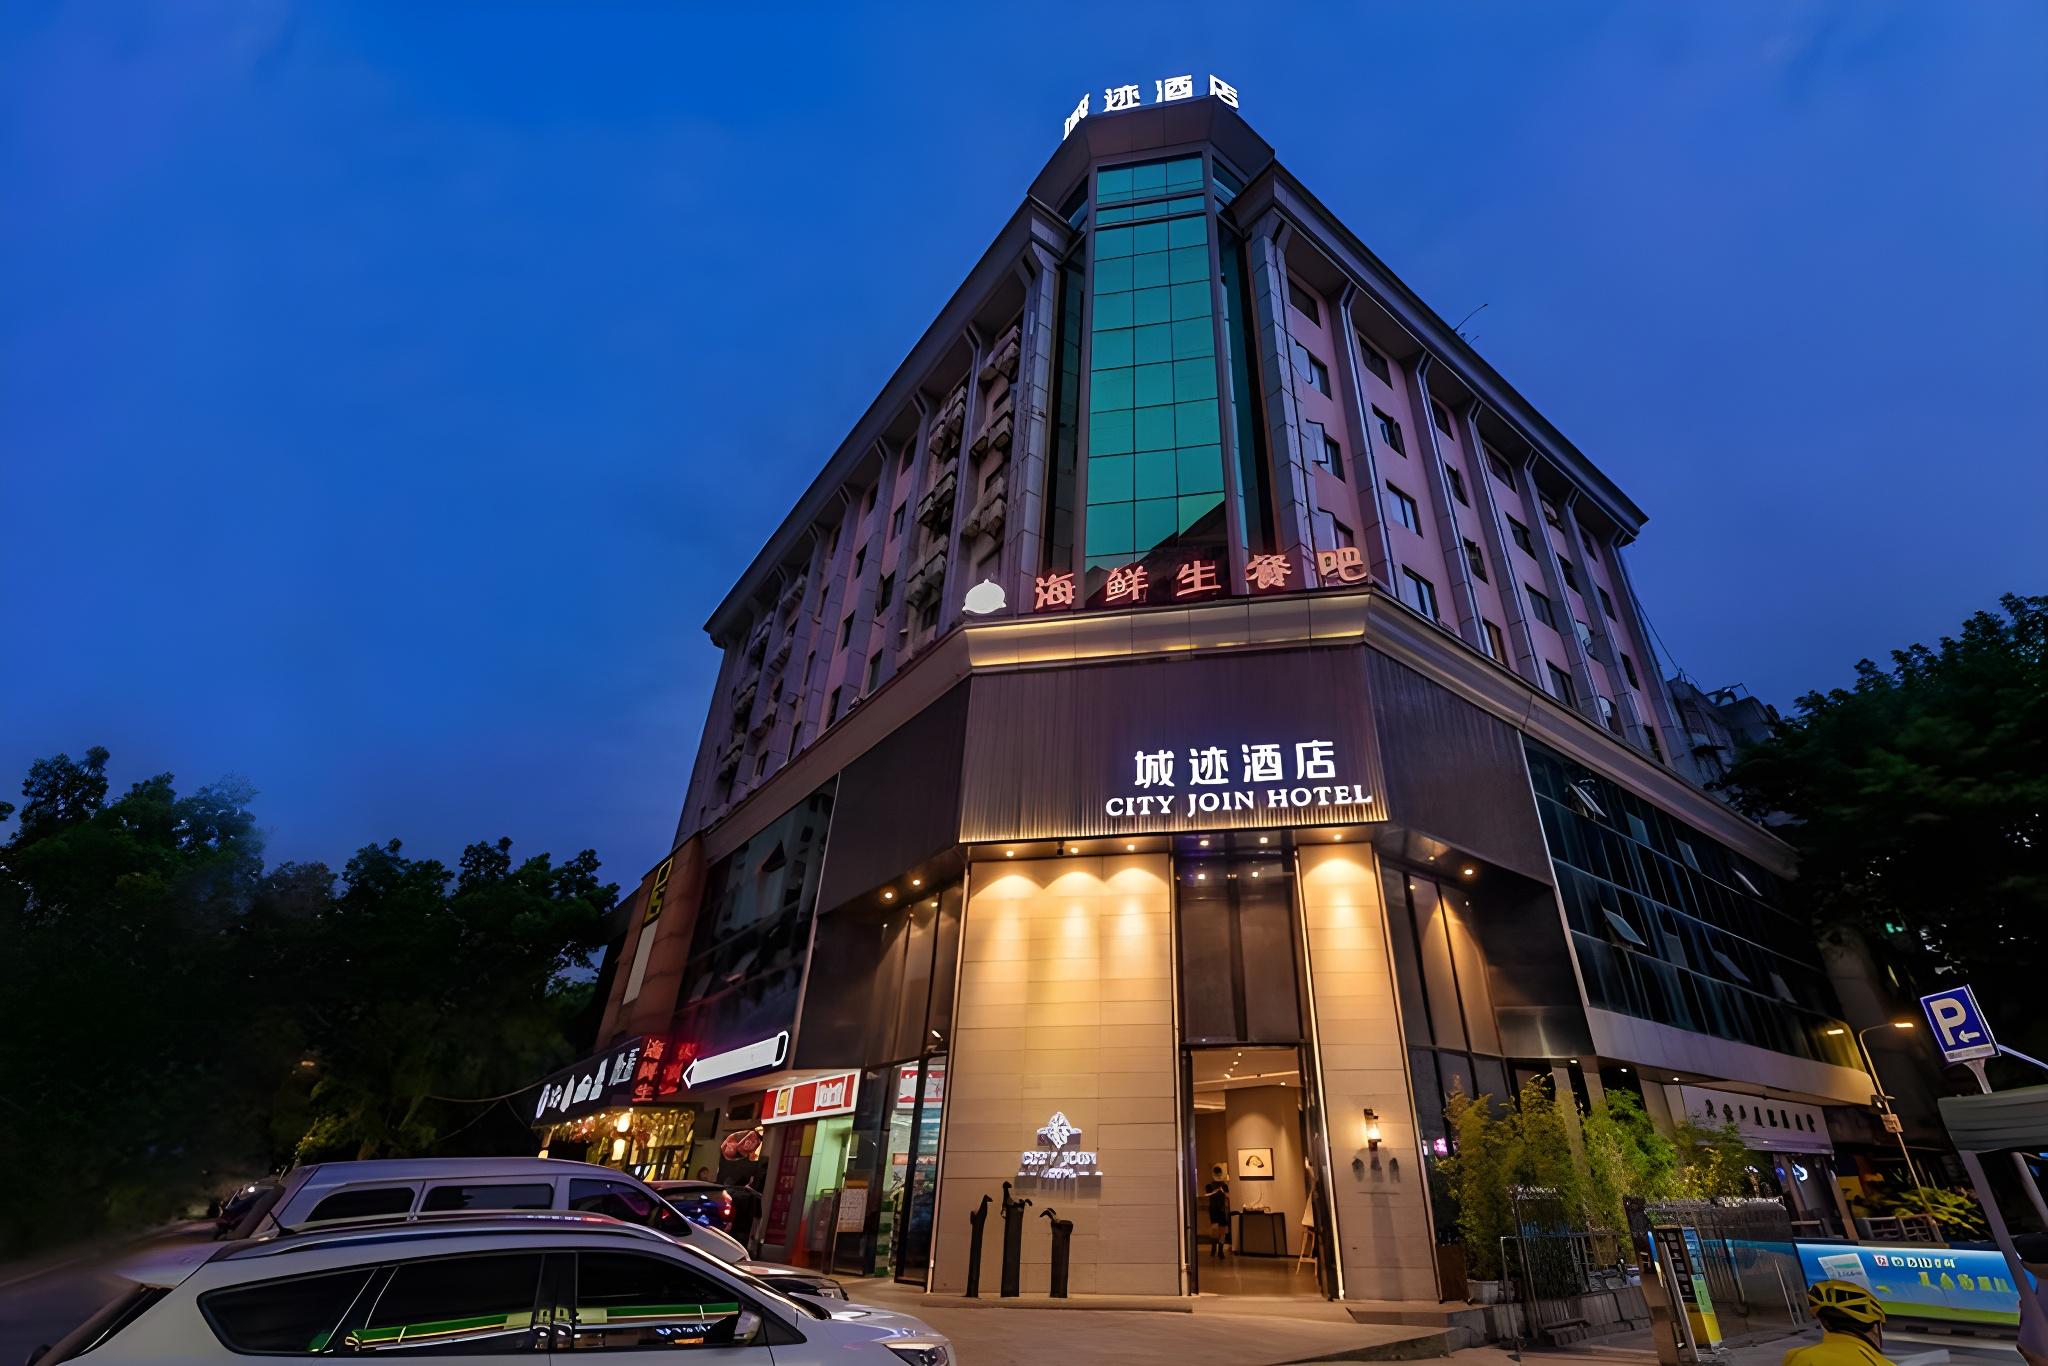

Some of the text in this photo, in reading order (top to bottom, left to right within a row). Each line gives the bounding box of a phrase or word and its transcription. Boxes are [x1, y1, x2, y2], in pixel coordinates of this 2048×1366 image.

[1134, 740, 1336, 789] 城迹酒店
[1105, 784, 1373, 817] CITY JOIN HOTEL
[1929, 998, 1967, 1046] P
